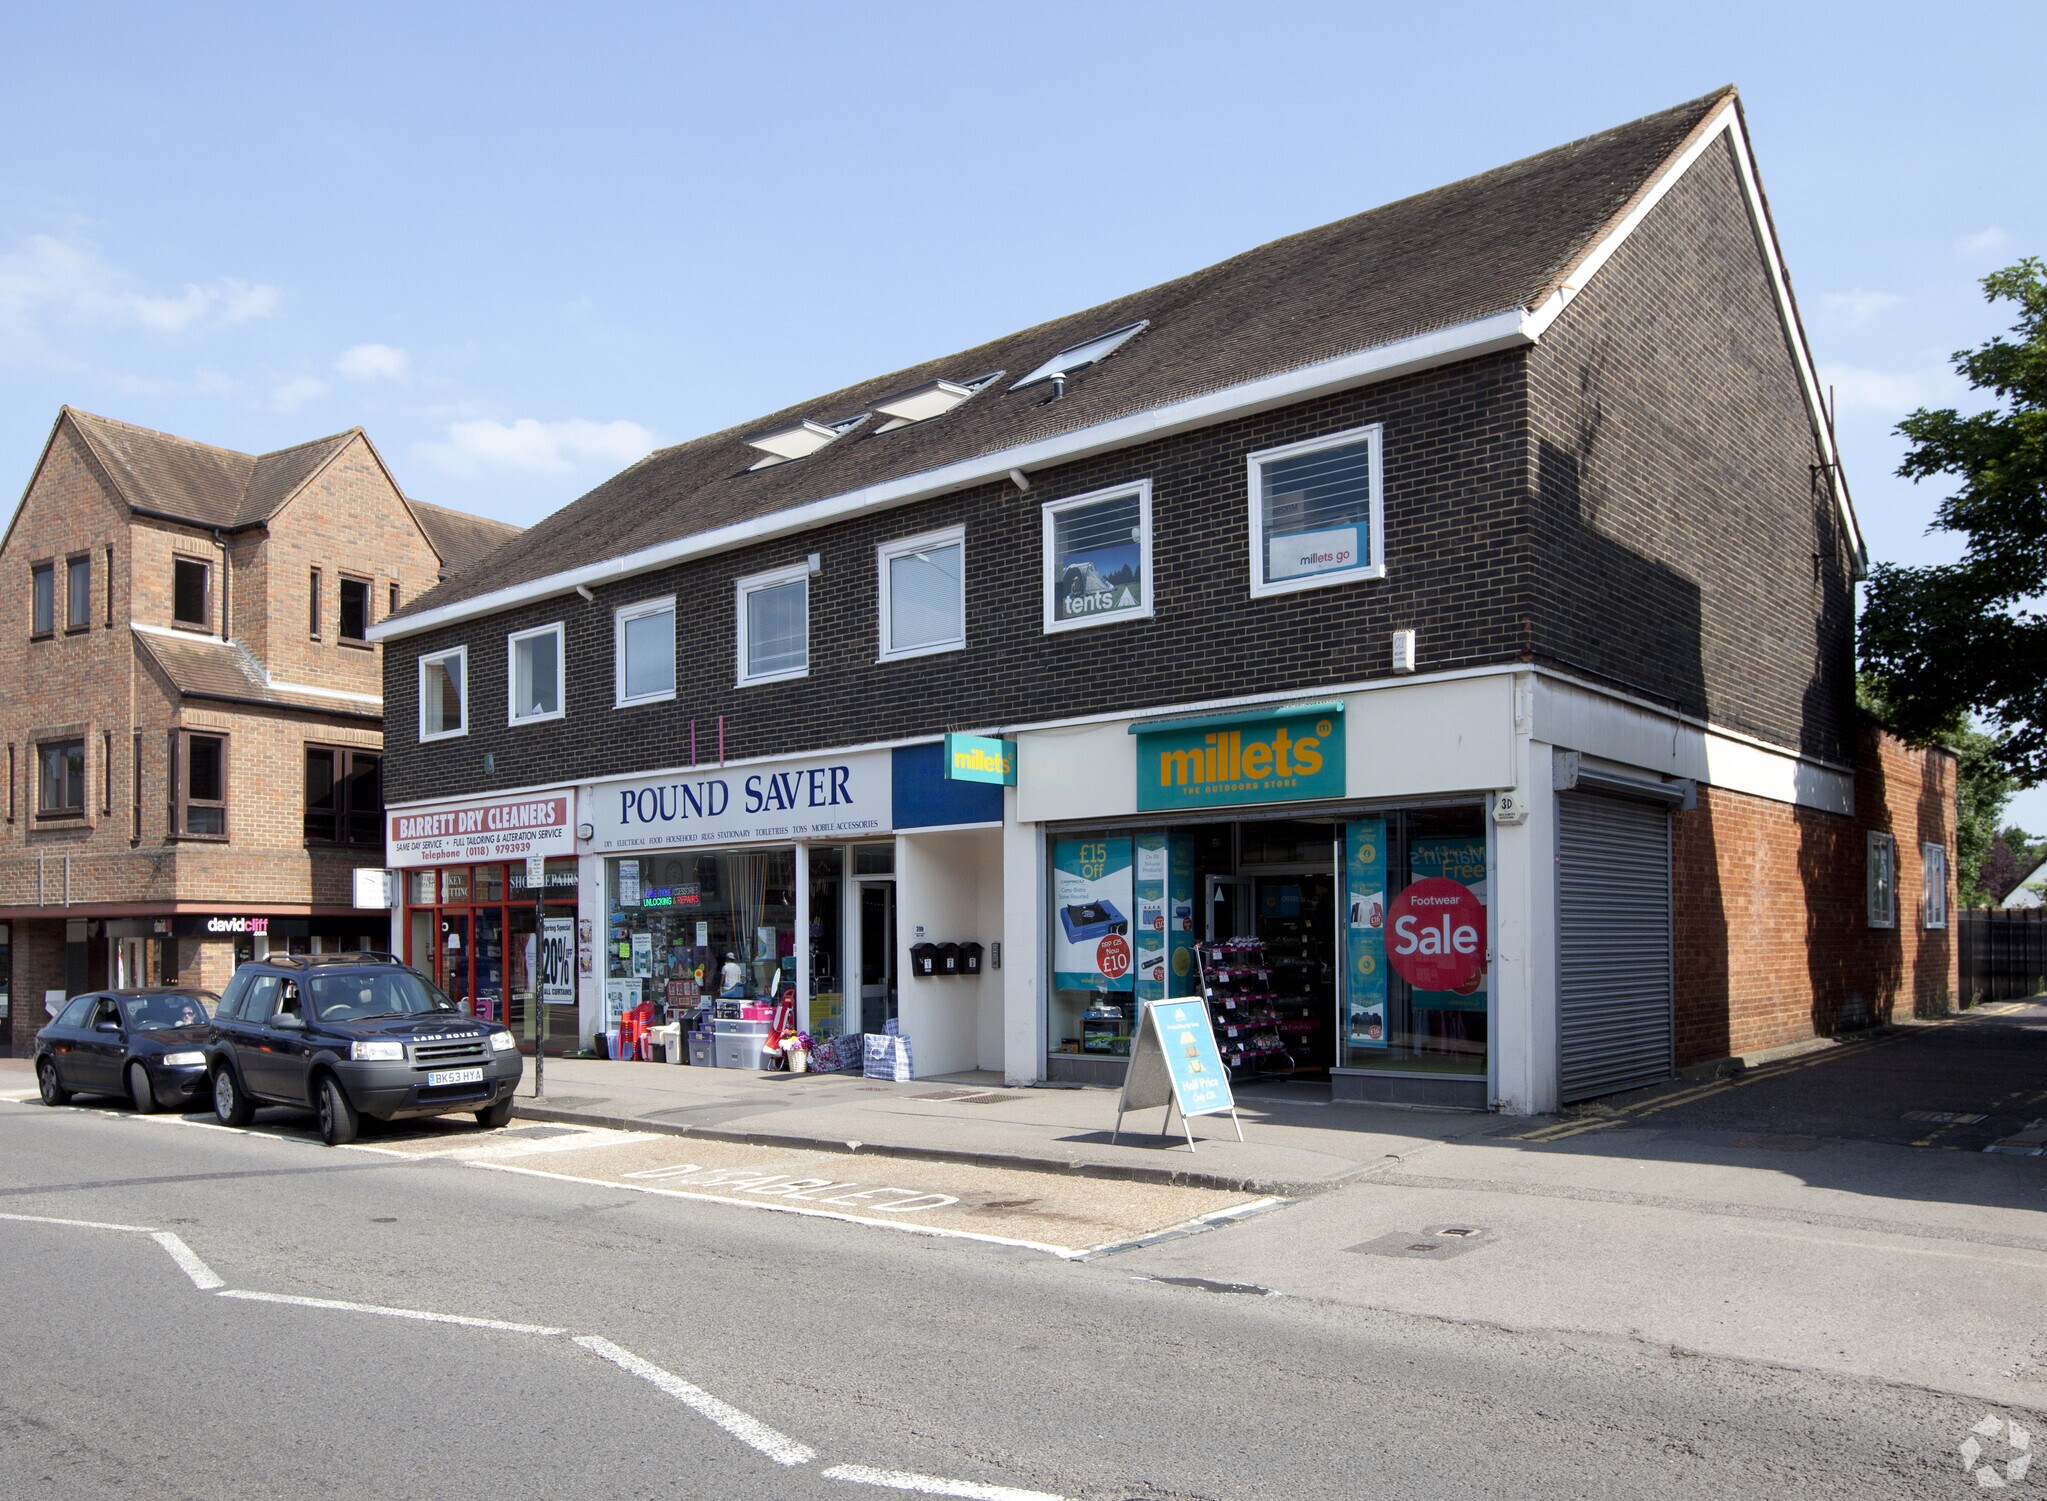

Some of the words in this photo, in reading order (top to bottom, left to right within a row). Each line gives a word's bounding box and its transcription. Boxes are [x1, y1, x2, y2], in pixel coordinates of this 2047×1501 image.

[1300, 553, 1333, 566] millets
[1336, 551, 1350, 564] go
[1065, 592, 1112, 614] tents
[955, 748, 1010, 774] millets
[1161, 728, 1322, 786] millets
[620, 780, 728, 824] POUND
[745, 766, 854, 814] SAVER
[1184, 787, 1200, 795] THE
[1206, 782, 1258, 793] OUTDOORS
[1264, 779, 1296, 789] STORE
[1502, 798, 1512, 810] 3D
[400, 813, 456, 838] BARRETT
[459, 810, 484, 832] DRY
[488, 802, 556, 830] CLEANERS
[396, 843, 410, 852] SAME
[412, 842, 421, 850] DAY
[422, 840, 442, 849] SERVICE
[453, 838, 465, 846] FULL
[466, 835, 494, 846] TAILORING
[496, 834, 500, 842] &
[502, 831, 537, 842] ALTERATION
[538, 828, 562, 839] SERVICE
[616, 838, 646, 847] ELECTRICAL
[649, 836, 662, 844] FOOD
[666, 834, 698, 843] HOUSEHOLD
[701, 832, 714, 840] RUGS
[718, 829, 750, 839] STATIONARY
[755, 826, 788, 836] TOILETRIES
[792, 825, 808, 834] TOYS
[812, 823, 834, 832] MOBILE
[836, 820, 878, 830] ACCESSORIES
[422, 850, 460, 862] Telephone
[466, 846, 490, 857] (0118)
[495, 842, 530, 854] 9793939
[1080, 844, 1106, 864] £15
[1082, 864, 1104, 878] Off
[1442, 860, 1484, 878] Free
[544, 873, 578, 887] EPAIRS
[644, 896, 672, 906] UNLOCKING
[677, 894, 698, 905] REPAIRS
[1411, 896, 1460, 906] Footwear
[208, 918, 268, 932] davidcliff
[1395, 914, 1478, 955] Sale
[544, 936, 569, 986] 20%
[1103, 954, 1126, 972] £10
[436, 1072, 460, 1084] BK53
[464, 1070, 481, 1081] HYA
[1182, 1079, 1199, 1092] Half
[1200, 1077, 1218, 1088] Price
[620, 1164, 960, 1213] DISABLED
